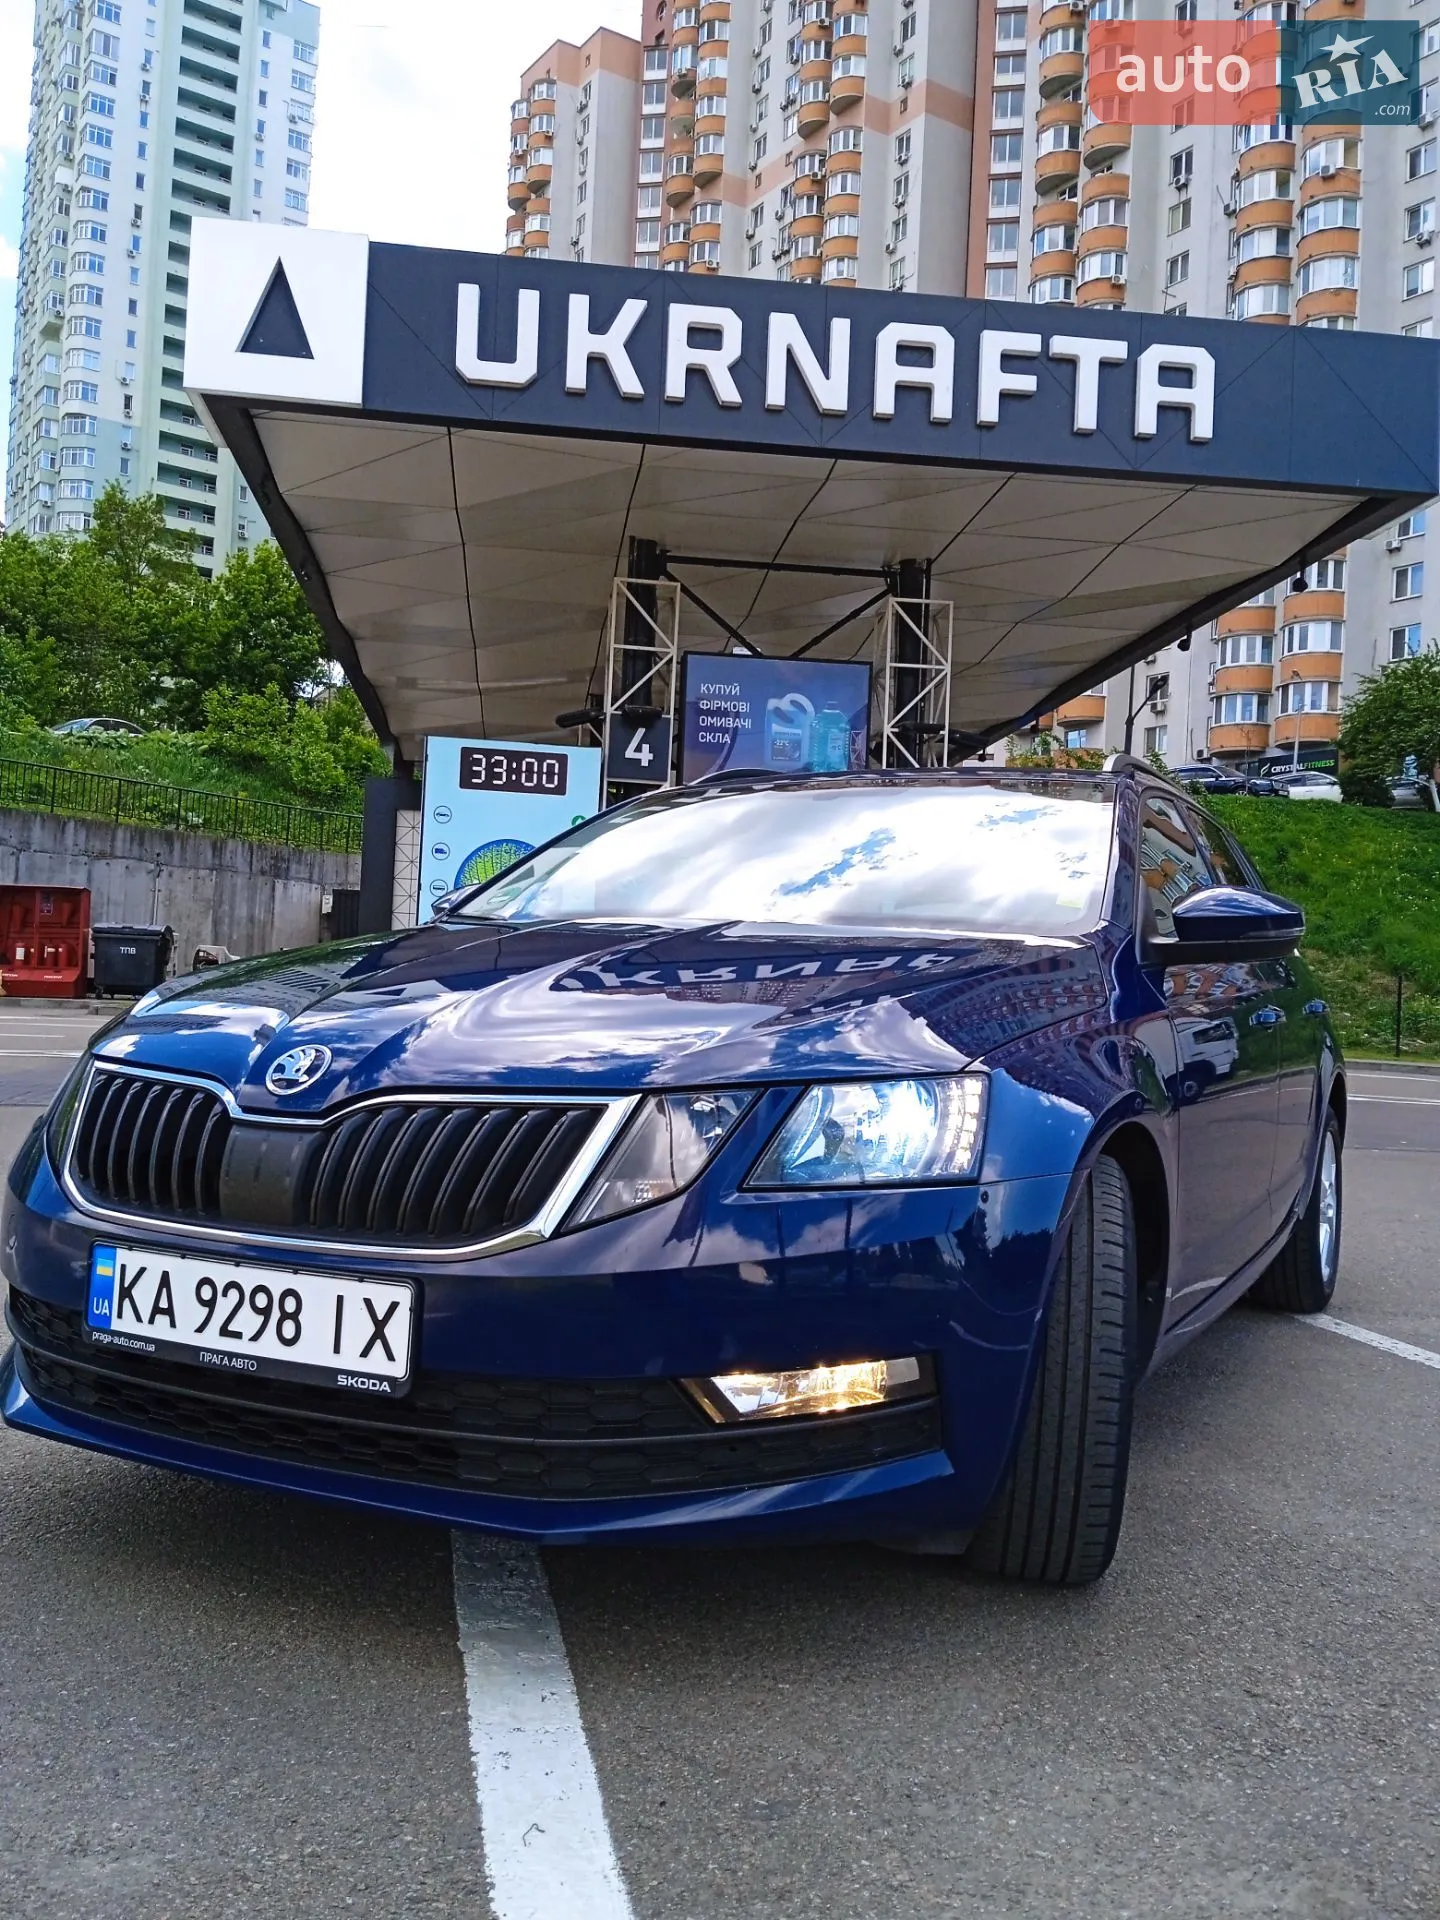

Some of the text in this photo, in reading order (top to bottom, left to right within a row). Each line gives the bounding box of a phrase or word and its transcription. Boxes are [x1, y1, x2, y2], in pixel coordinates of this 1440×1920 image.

[454, 282, 1216, 444] UKRNAFTA
[700, 683, 740, 696] КУПУЙ
[699, 700, 750, 713] ФІРМОВІ
[699, 715, 752, 729] ОМИВАЧІ
[624, 727, 654, 767] 4
[698, 731, 731, 744] СКЛА
[470, 754, 559, 788] 33:00
[93, 1297, 110, 1317] UA
[116, 1263, 400, 1362] KA 9298 IX
[92, 1331, 155, 1352] praga-auto.com.ua
[199, 1351, 257, 1371] ПРАГА АВТО
